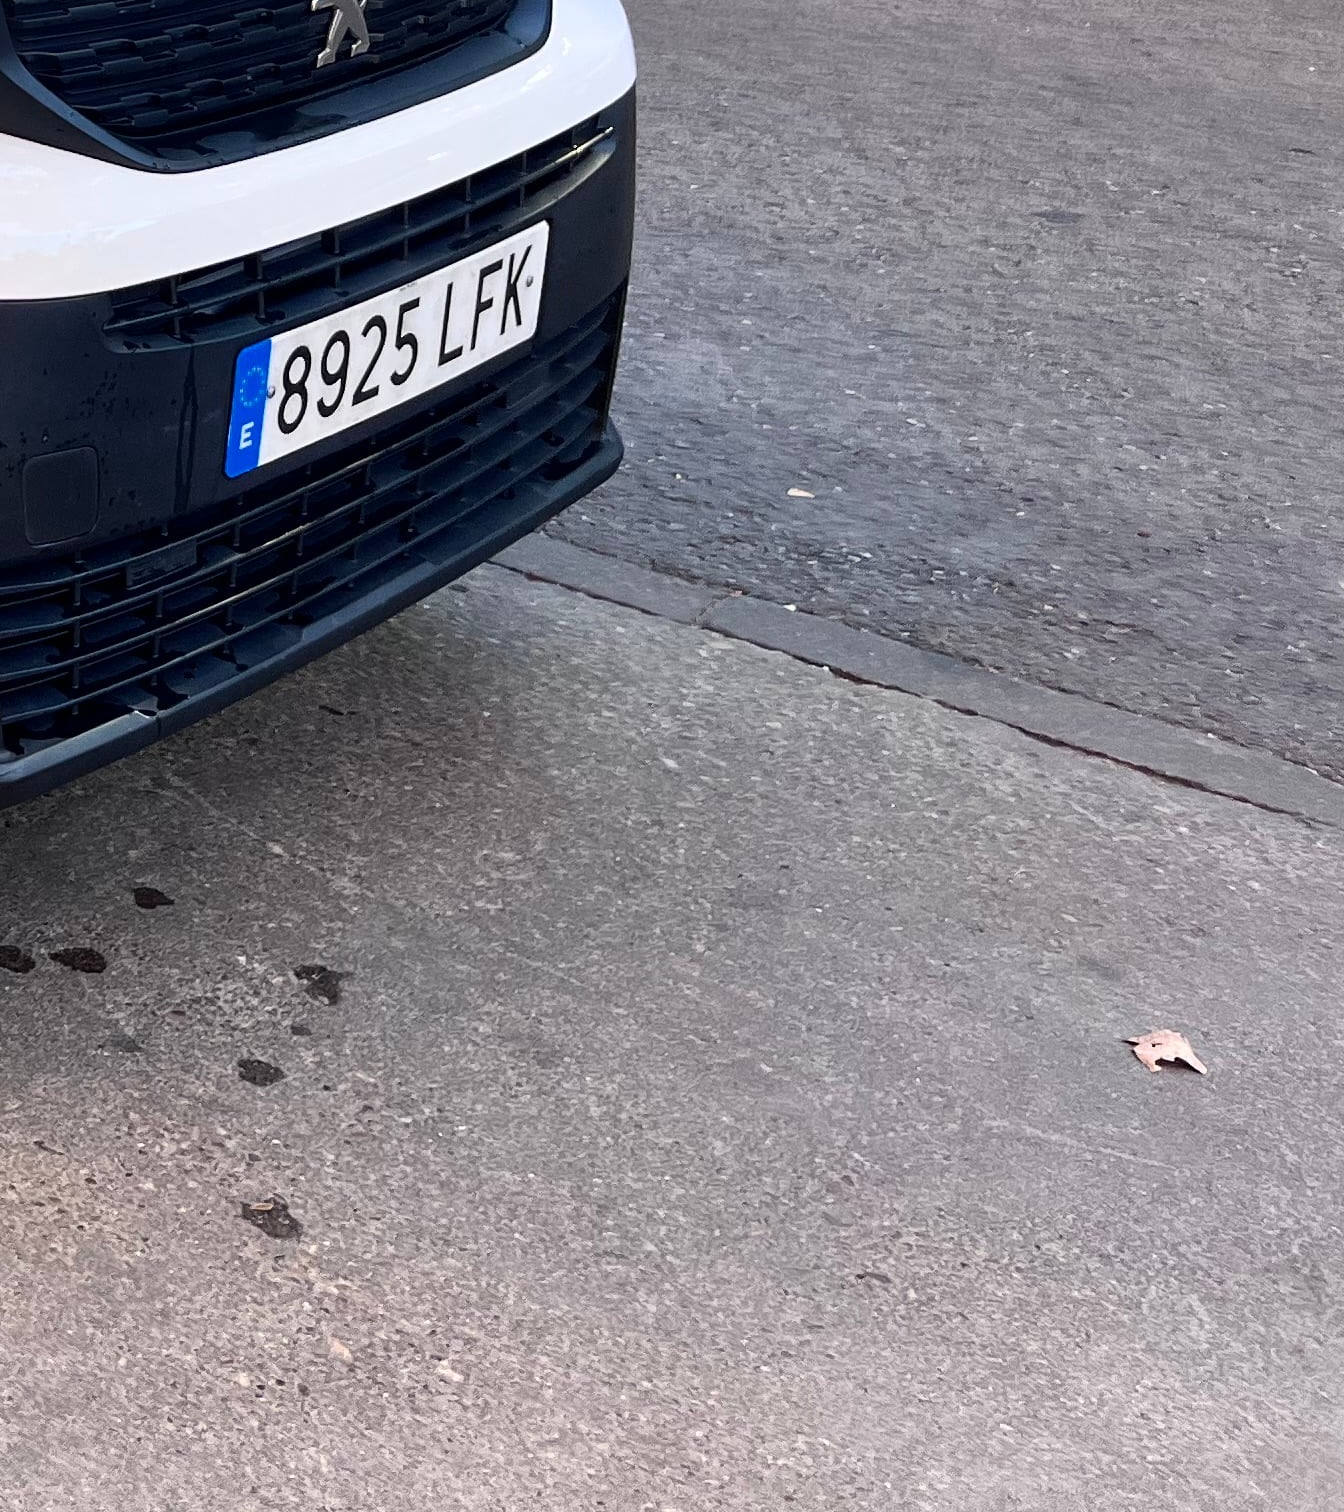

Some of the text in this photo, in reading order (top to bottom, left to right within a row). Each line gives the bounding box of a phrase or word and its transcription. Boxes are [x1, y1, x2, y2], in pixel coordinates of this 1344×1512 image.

[277, 245, 533, 435] 8925 LFK
[238, 421, 255, 450] E
